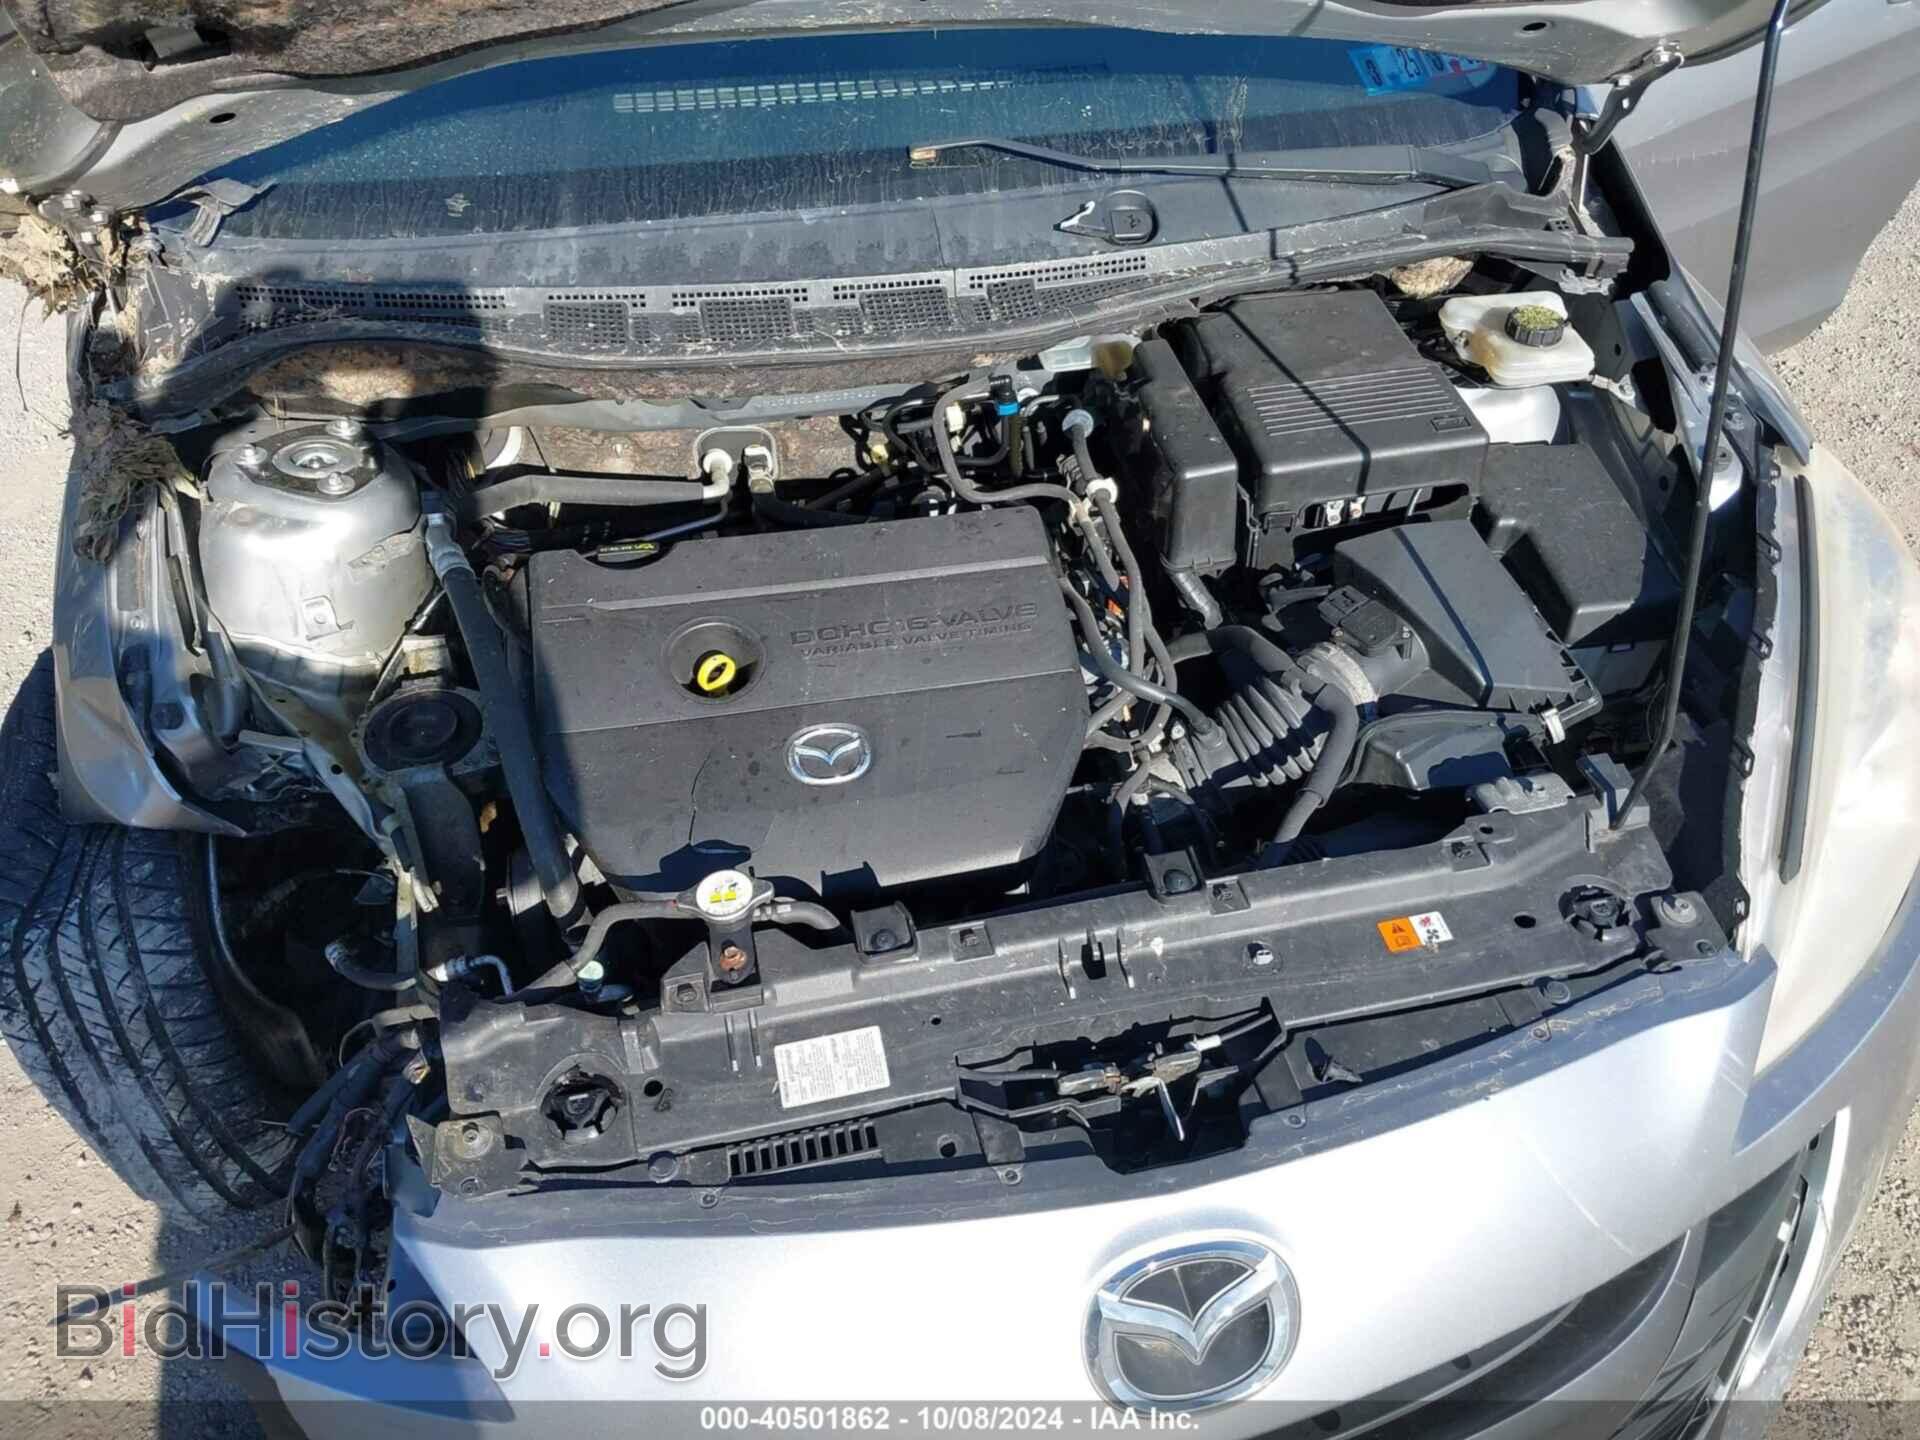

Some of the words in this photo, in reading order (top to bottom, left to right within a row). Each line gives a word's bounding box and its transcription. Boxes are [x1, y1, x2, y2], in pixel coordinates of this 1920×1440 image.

[790, 619, 893, 645] DOHC
[800, 639, 898, 658] VARIABLE
[902, 630, 962, 646] VALVE
[967, 623, 1033, 639] TIMING
